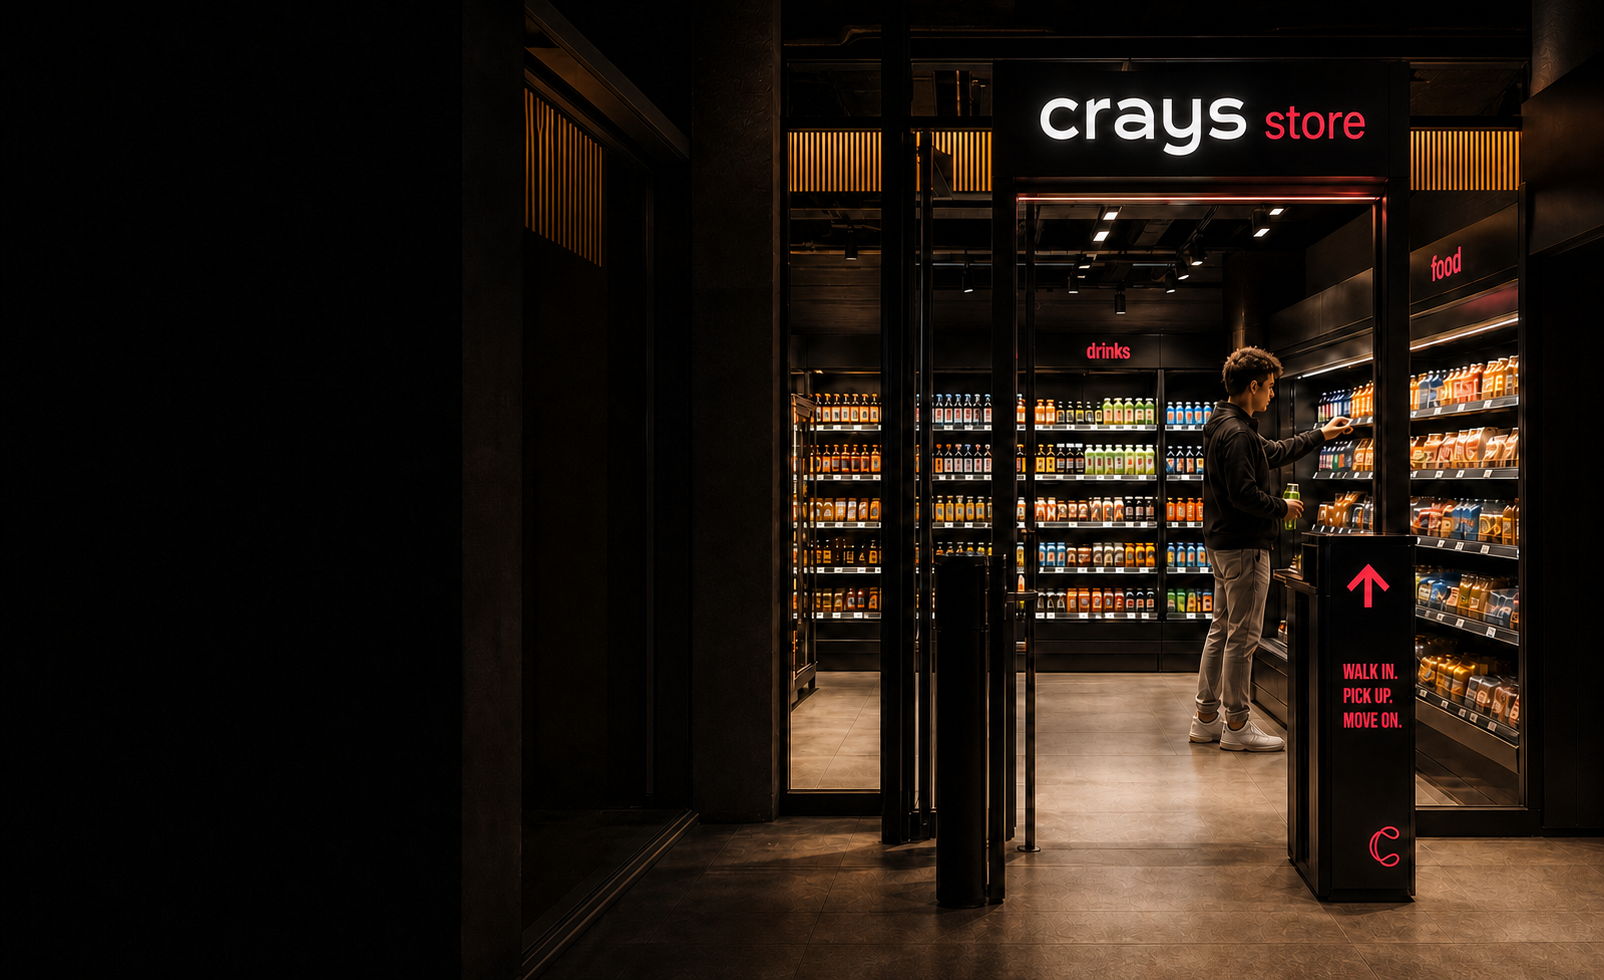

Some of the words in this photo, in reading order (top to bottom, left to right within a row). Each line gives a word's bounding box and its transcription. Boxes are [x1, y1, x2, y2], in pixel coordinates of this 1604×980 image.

[1039, 96, 1248, 156] crays
[1264, 105, 1366, 140] store
[1430, 245, 1463, 282] food
[1086, 341, 1131, 360] drinks
[1342, 663, 1379, 680] WALK
[1381, 663, 1399, 680] IN.
[1343, 687, 1372, 704] PICK
[1374, 687, 1393, 704] UP.
[1343, 711, 1379, 729] MOVE
[1381, 711, 1403, 729] ON.
